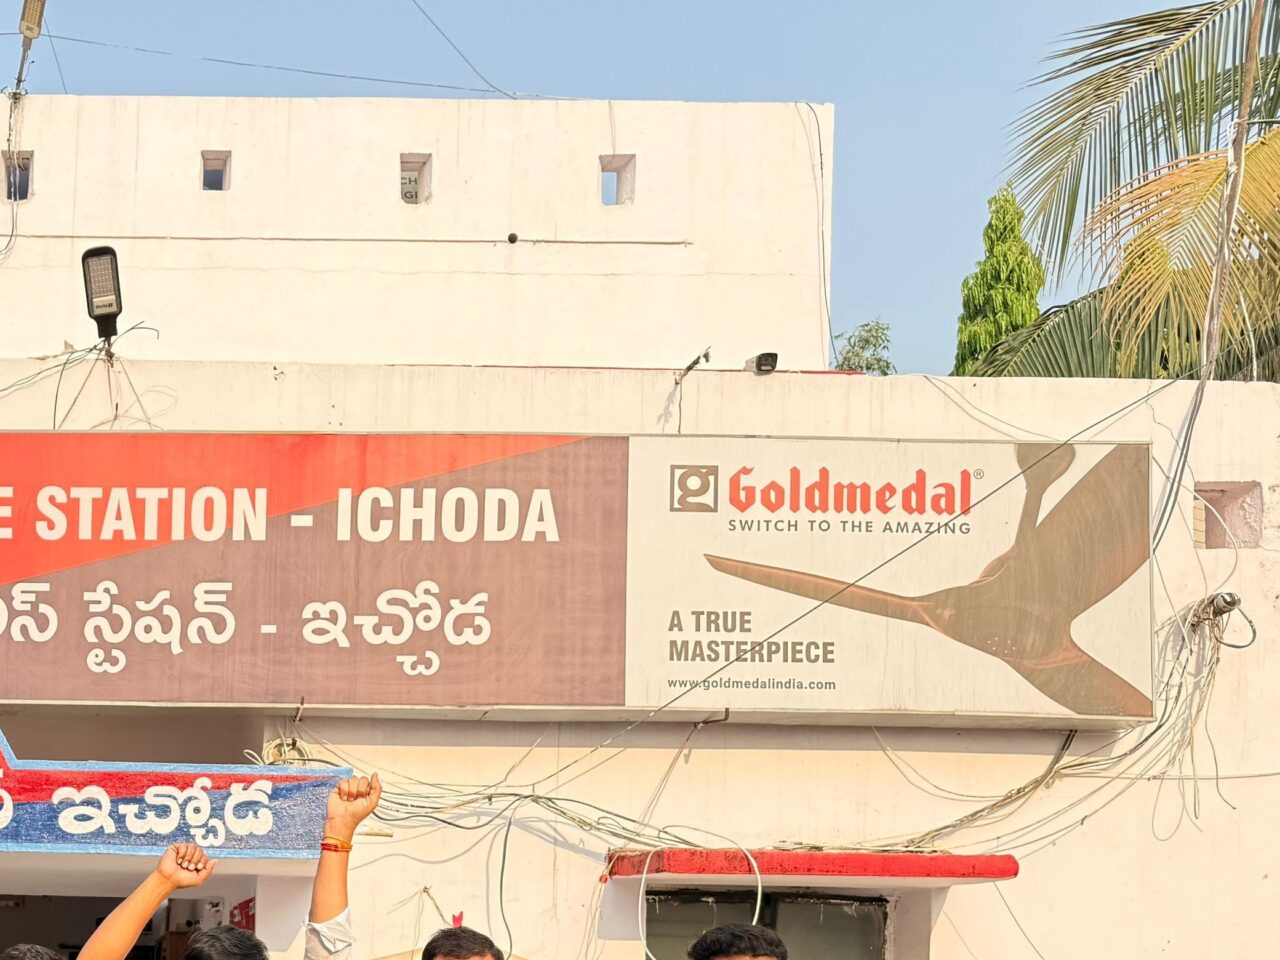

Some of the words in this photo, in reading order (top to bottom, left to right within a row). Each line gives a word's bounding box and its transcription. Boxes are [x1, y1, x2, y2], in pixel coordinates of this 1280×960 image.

[729, 465, 971, 516] Goldmedal
[35, 485, 267, 541] STATION
[290, 514, 313, 527] -
[336, 487, 559, 542] ICHODA
[728, 519, 798, 532] SWITCH
[808, 520, 830, 533] TO
[841, 520, 873, 533] THE
[882, 521, 971, 534] AMAZING
[83, 580, 236, 674] స్టేషన్
[260, 624, 277, 634] -
[302, 580, 492, 676] ఇచ్చోడ
[668, 610, 683, 633] A
[691, 610, 752, 633] TRUE
[669, 640, 835, 664] MASTERPIECE
[668, 677, 836, 691] www.goldmedalindia.com
[52, 776, 273, 847] ఇచ్చోడ
